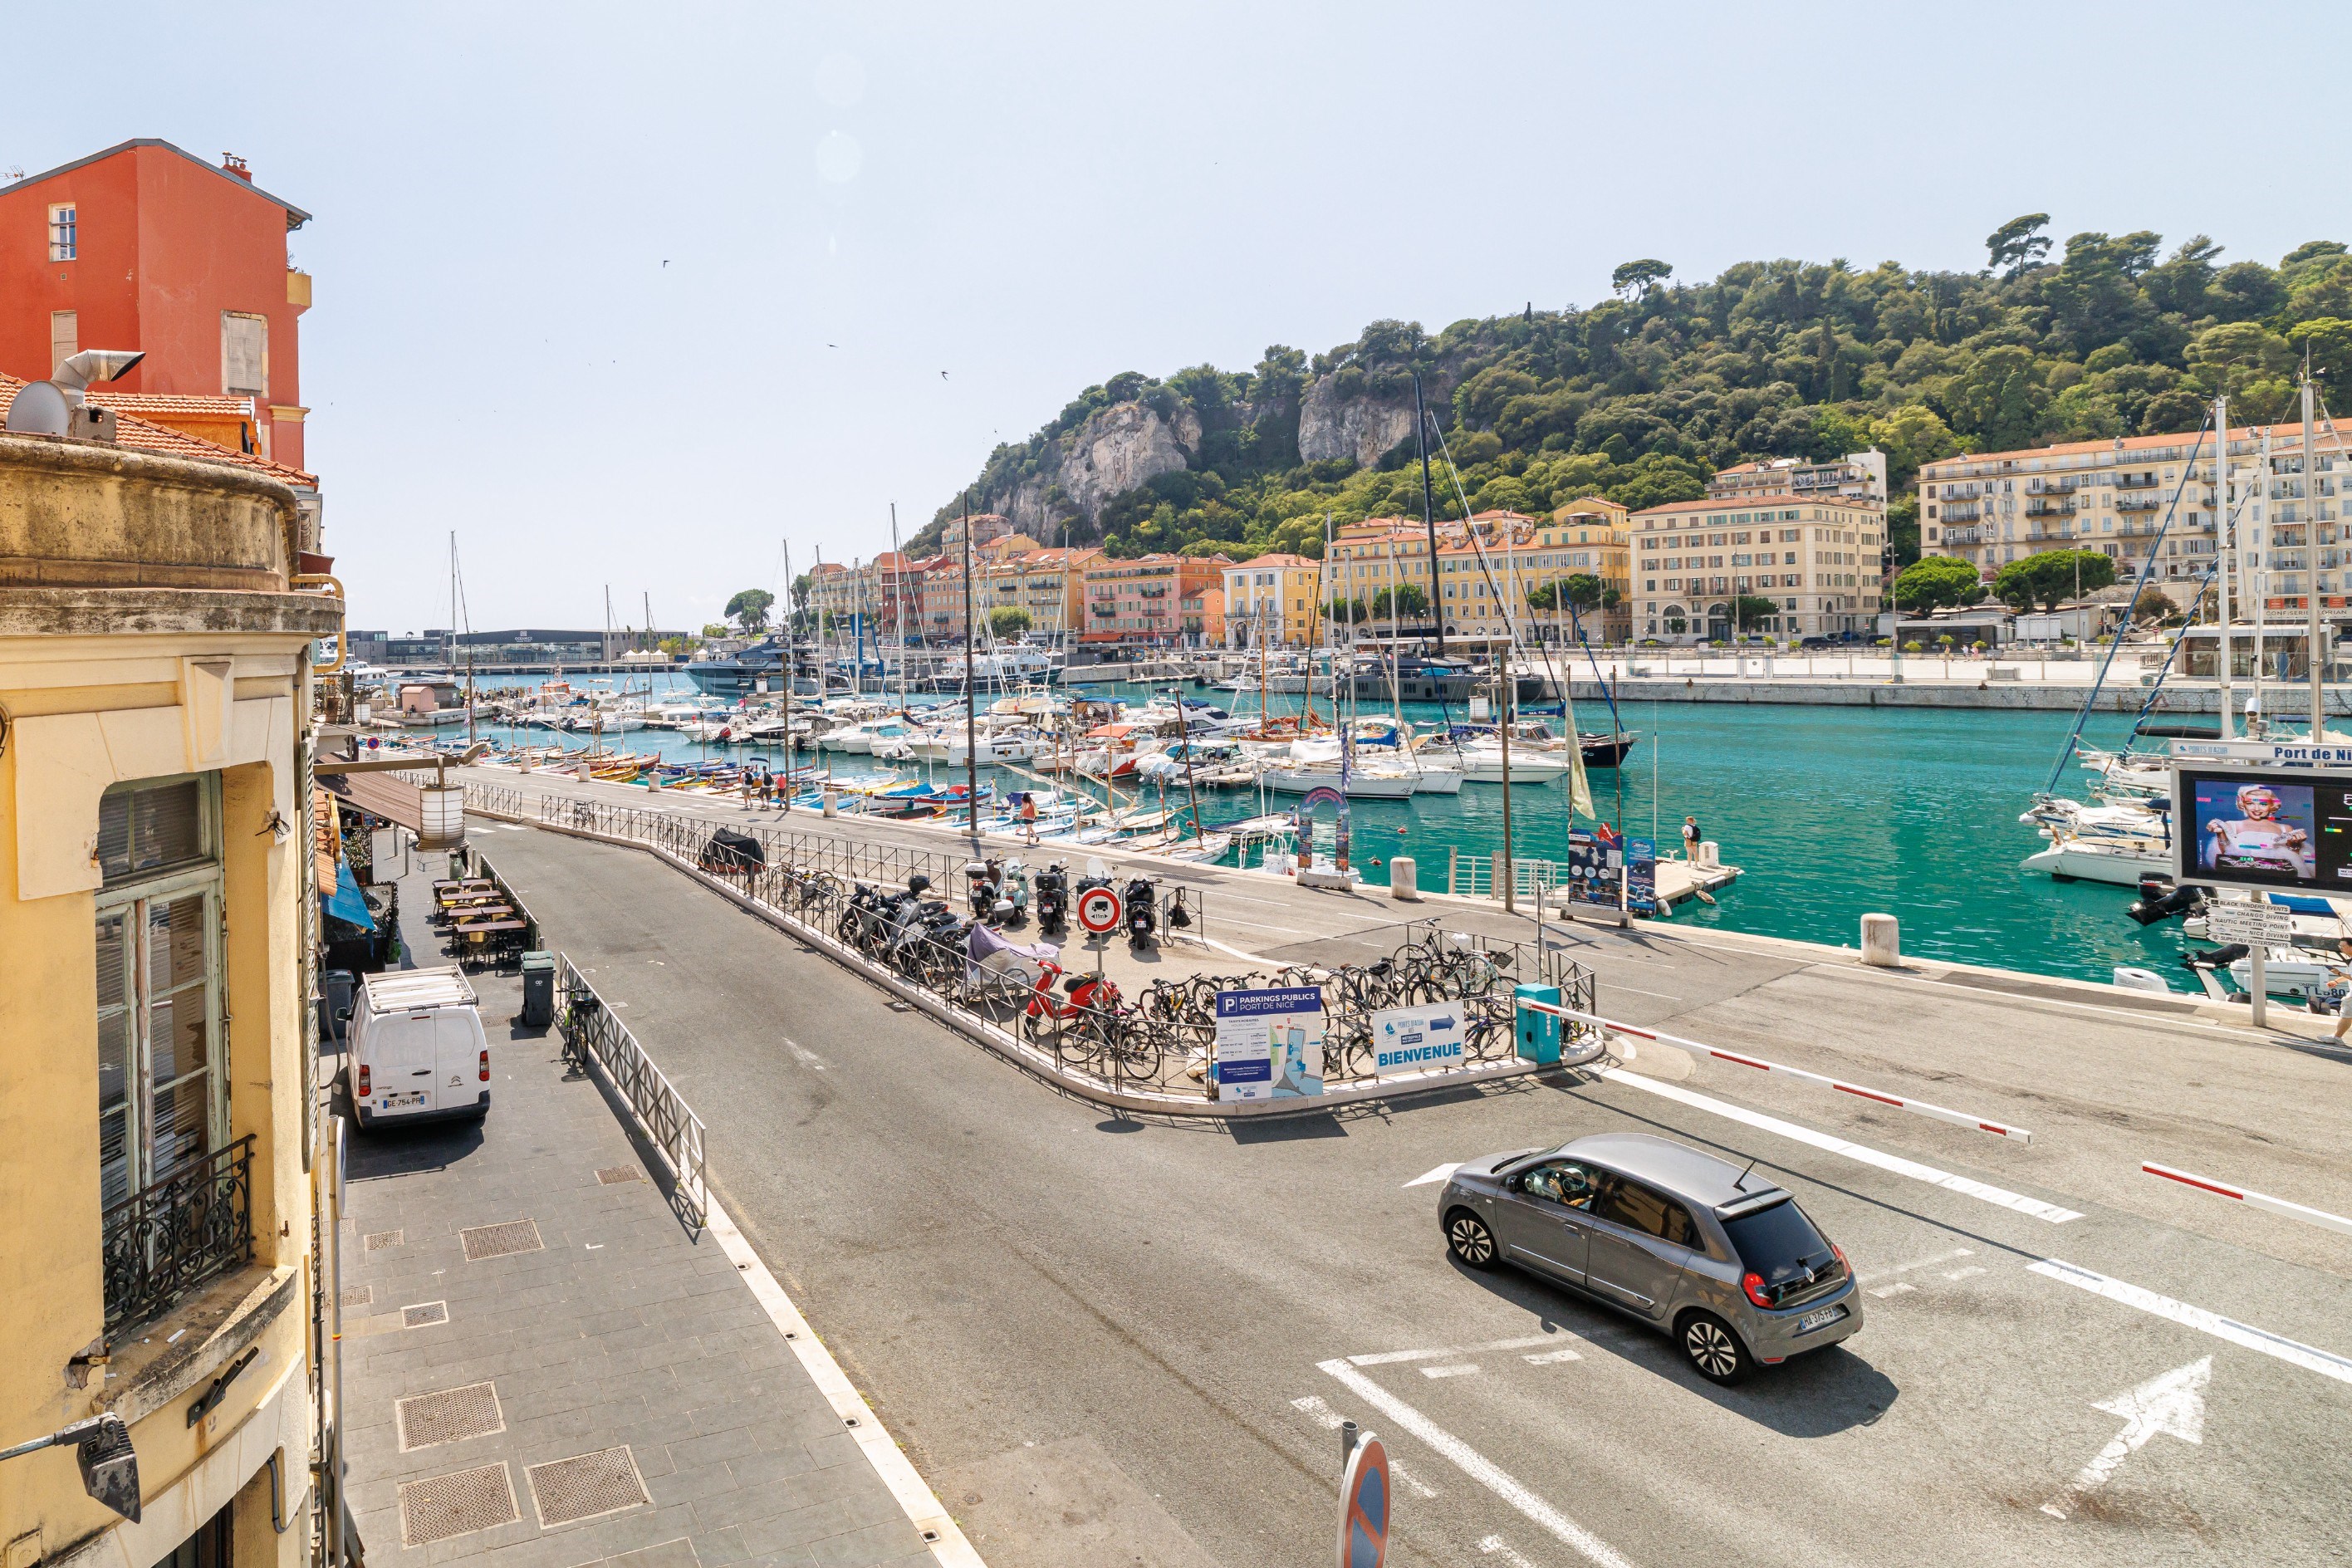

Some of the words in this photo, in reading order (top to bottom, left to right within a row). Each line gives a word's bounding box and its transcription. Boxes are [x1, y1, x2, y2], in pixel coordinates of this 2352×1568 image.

[2188, 745, 2207, 753] PORTS
[2274, 747, 2307, 758] Port
[2311, 748, 2330, 760] de
[2248, 938, 2289, 948] WATERSPORTS
[1239, 994, 1280, 1004] PARKINGS
[1281, 993, 1316, 1002] PUBLICS
[1239, 1002, 1262, 1011] PORT
[1262, 1002, 1274, 1010] DE
[1276, 1001, 1295, 1009] NICE
[1379, 1041, 1462, 1066] BIENVENUE
